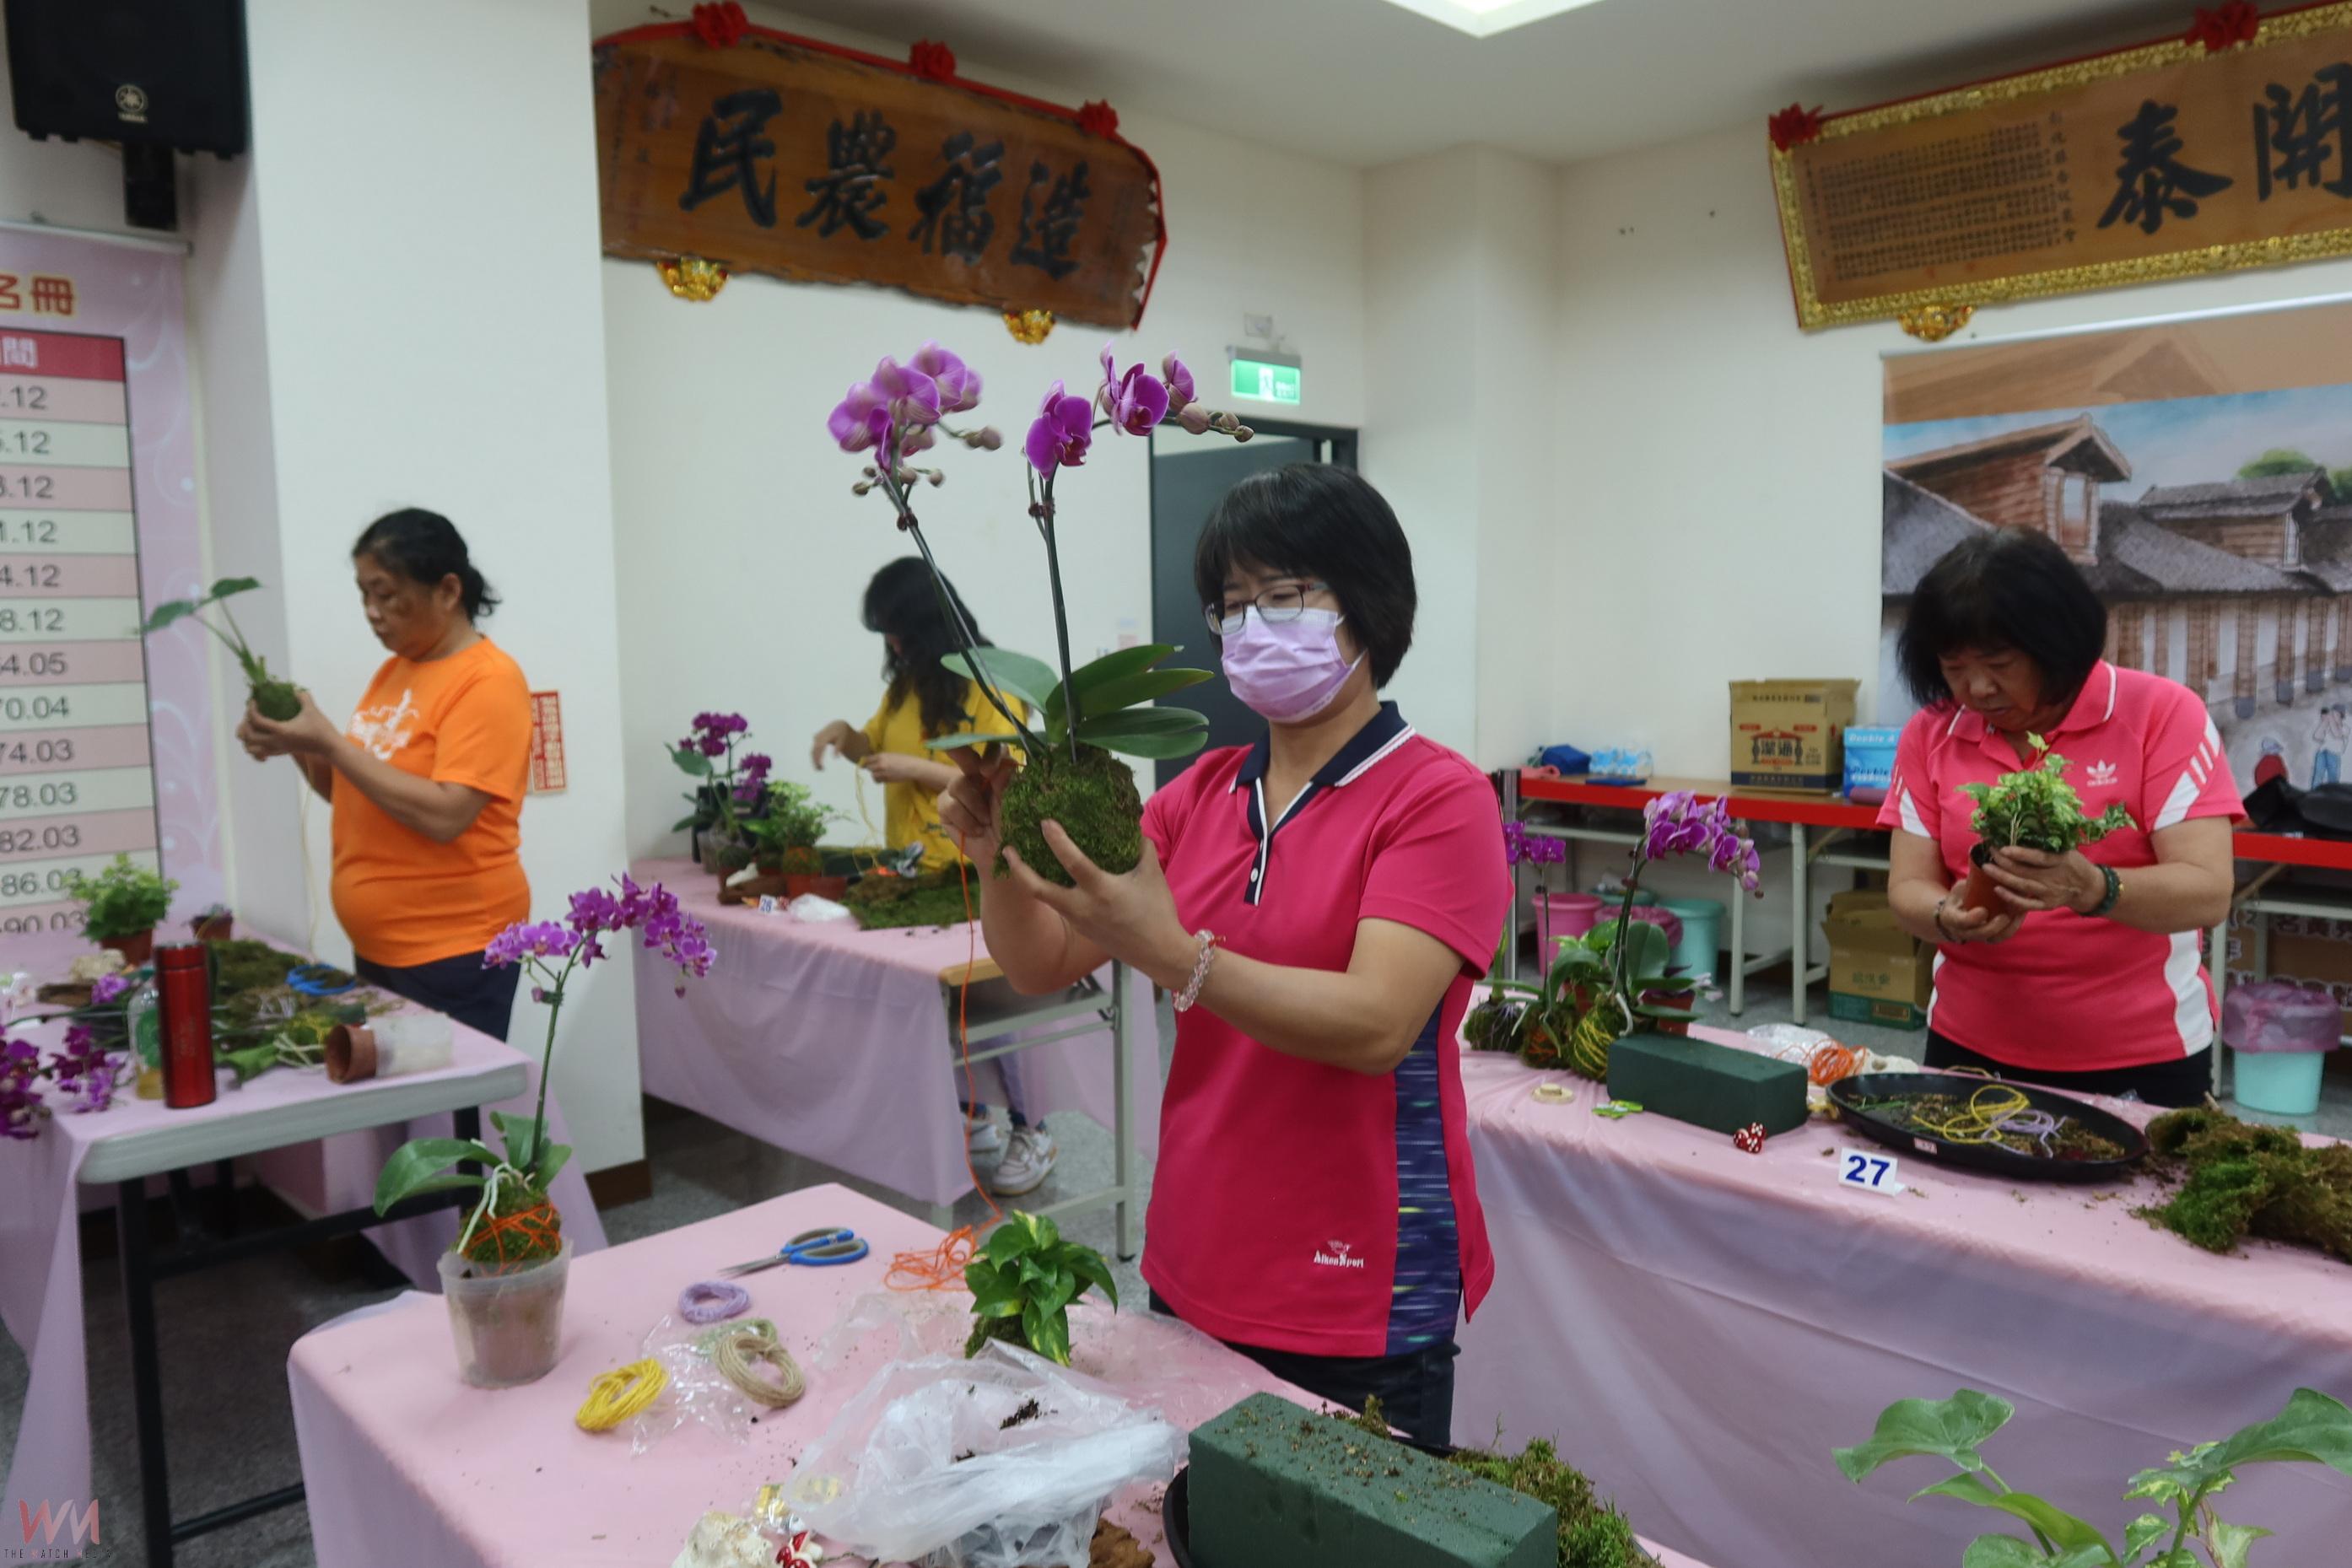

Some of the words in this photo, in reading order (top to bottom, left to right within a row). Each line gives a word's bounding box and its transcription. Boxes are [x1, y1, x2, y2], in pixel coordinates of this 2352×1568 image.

[0, 385, 47, 410] .12
[0, 696, 69, 720] 0.04
[0, 824, 79, 853] 82.03
[1845, 1155, 1891, 1186] 27
